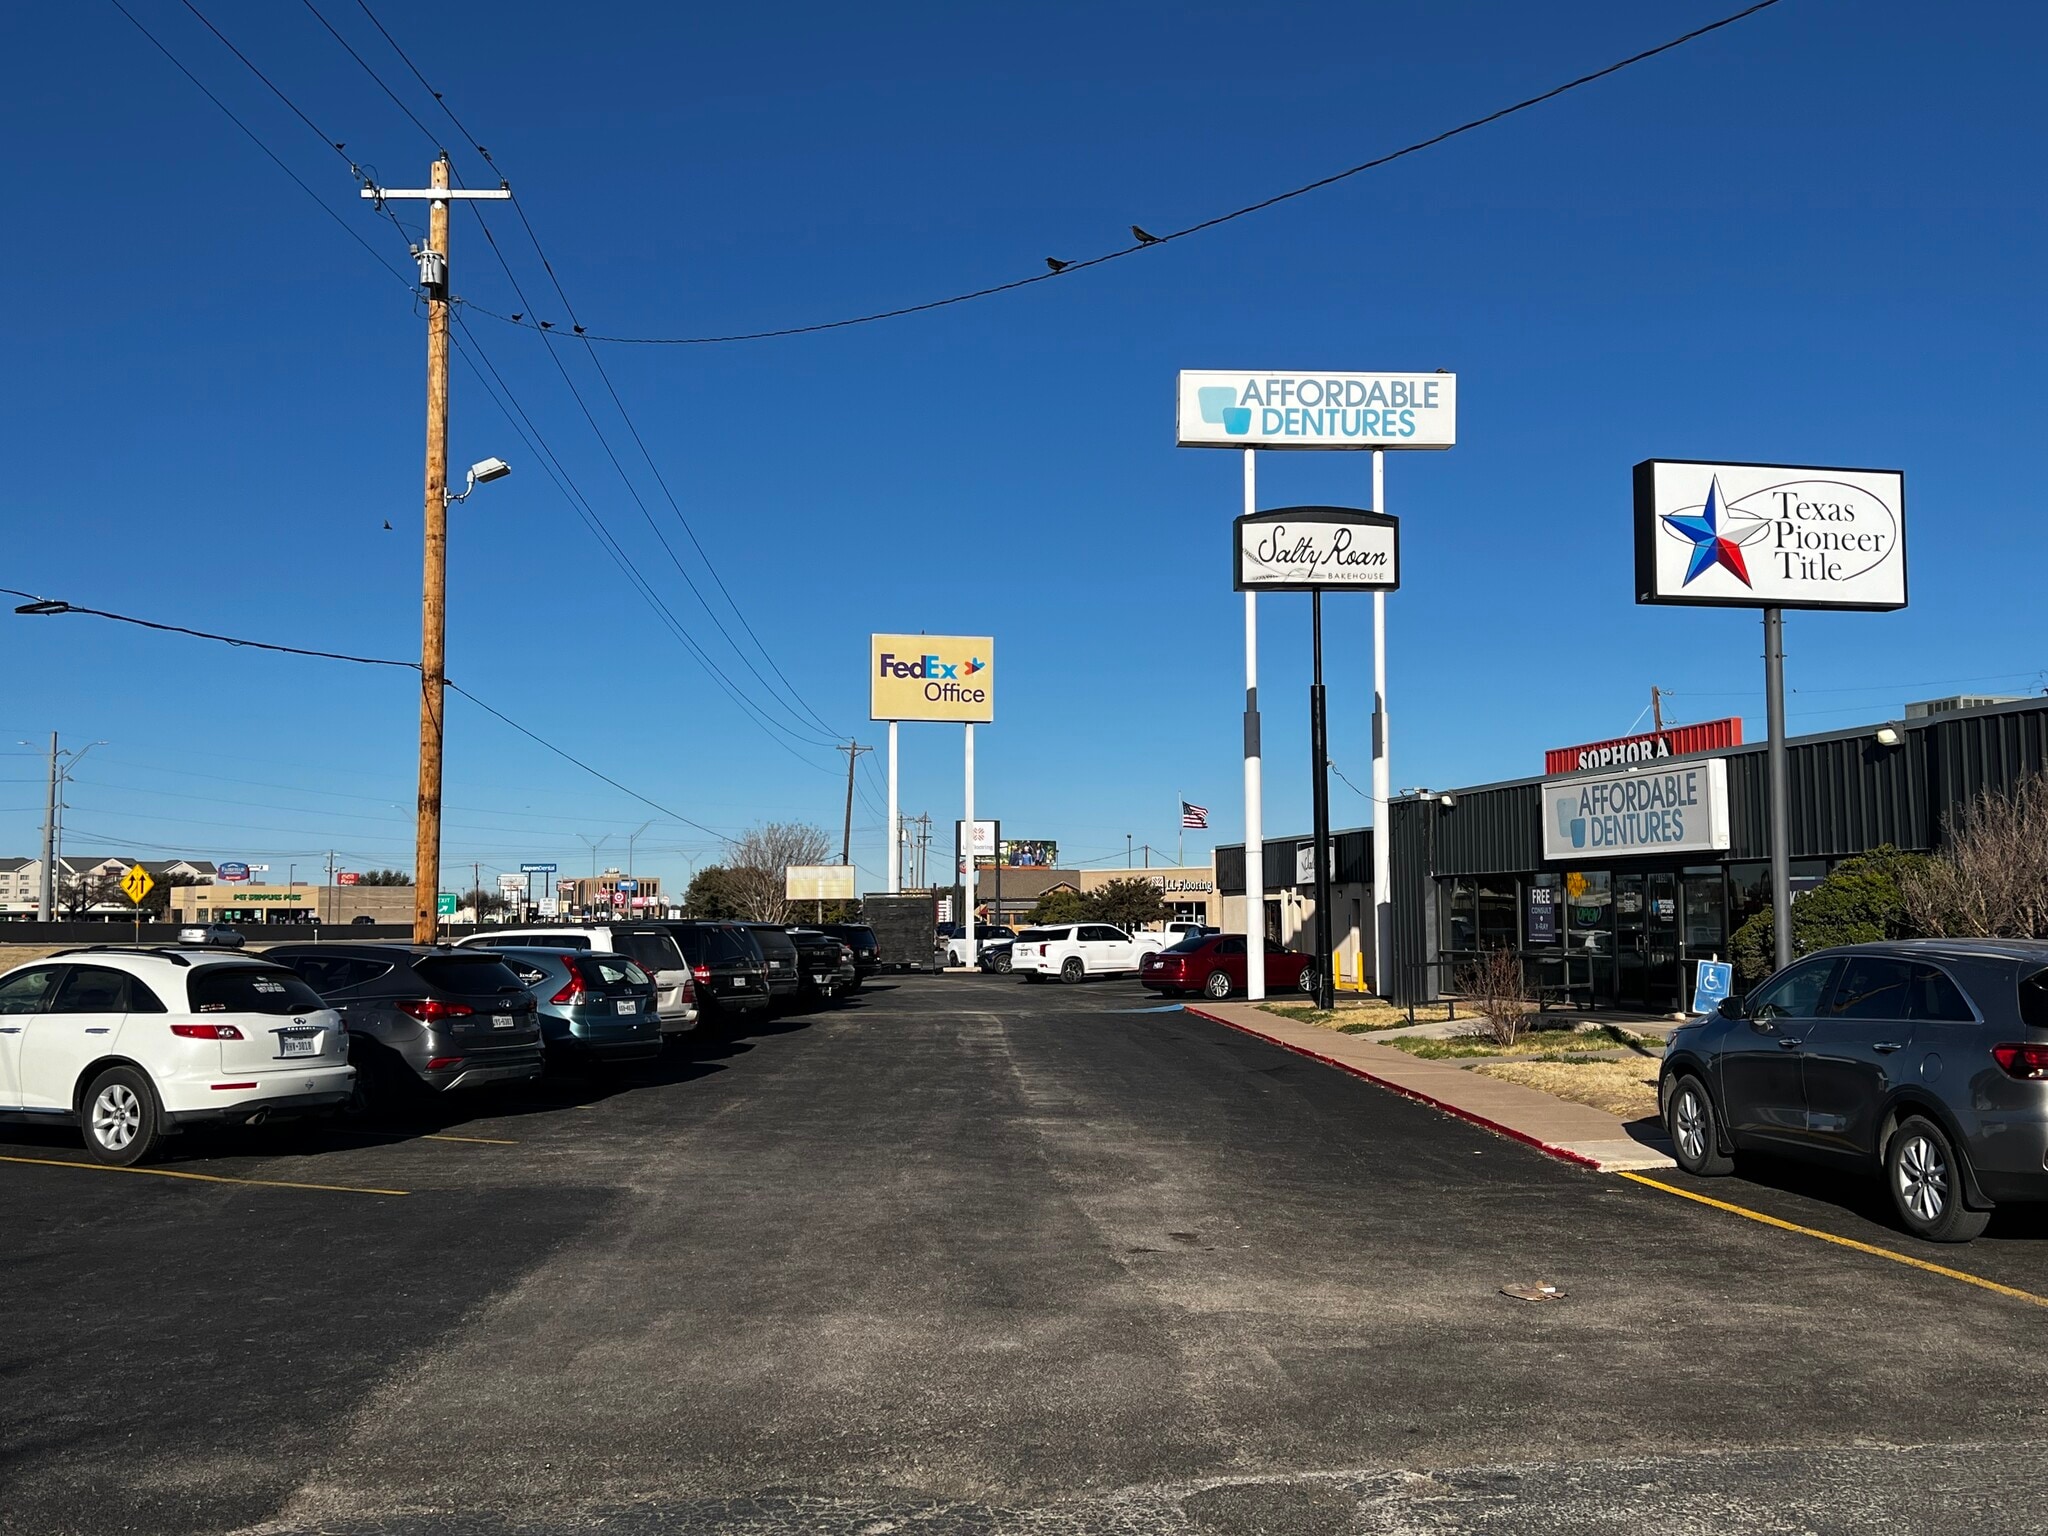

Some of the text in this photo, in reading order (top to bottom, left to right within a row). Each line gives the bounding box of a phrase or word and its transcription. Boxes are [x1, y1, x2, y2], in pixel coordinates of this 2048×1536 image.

[1240, 379, 1439, 409] AFFORDABLE
[1262, 408, 1416, 437] DENTURES
[1772, 491, 1855, 522] Texas
[1774, 520, 1886, 552] Pioneer
[1258, 525, 1388, 578] Salty Roan
[1774, 551, 1843, 581] Title
[1327, 572, 1385, 581] BAKEHOUSE
[880, 653, 958, 680] FedEx
[924, 682, 985, 703] Office
[1578, 737, 1669, 770] SOPHORA
[1579, 772, 1698, 817] AFFORDABLE
[1591, 808, 1684, 847] DENTURES
[1166, 879, 1213, 893] LL Flooring
[1532, 889, 1550, 904] FREE
[1531, 906, 1552, 915] CONSULT
[1578, 907, 1599, 923] OPEN
[1534, 923, 1549, 931] X-RAY
